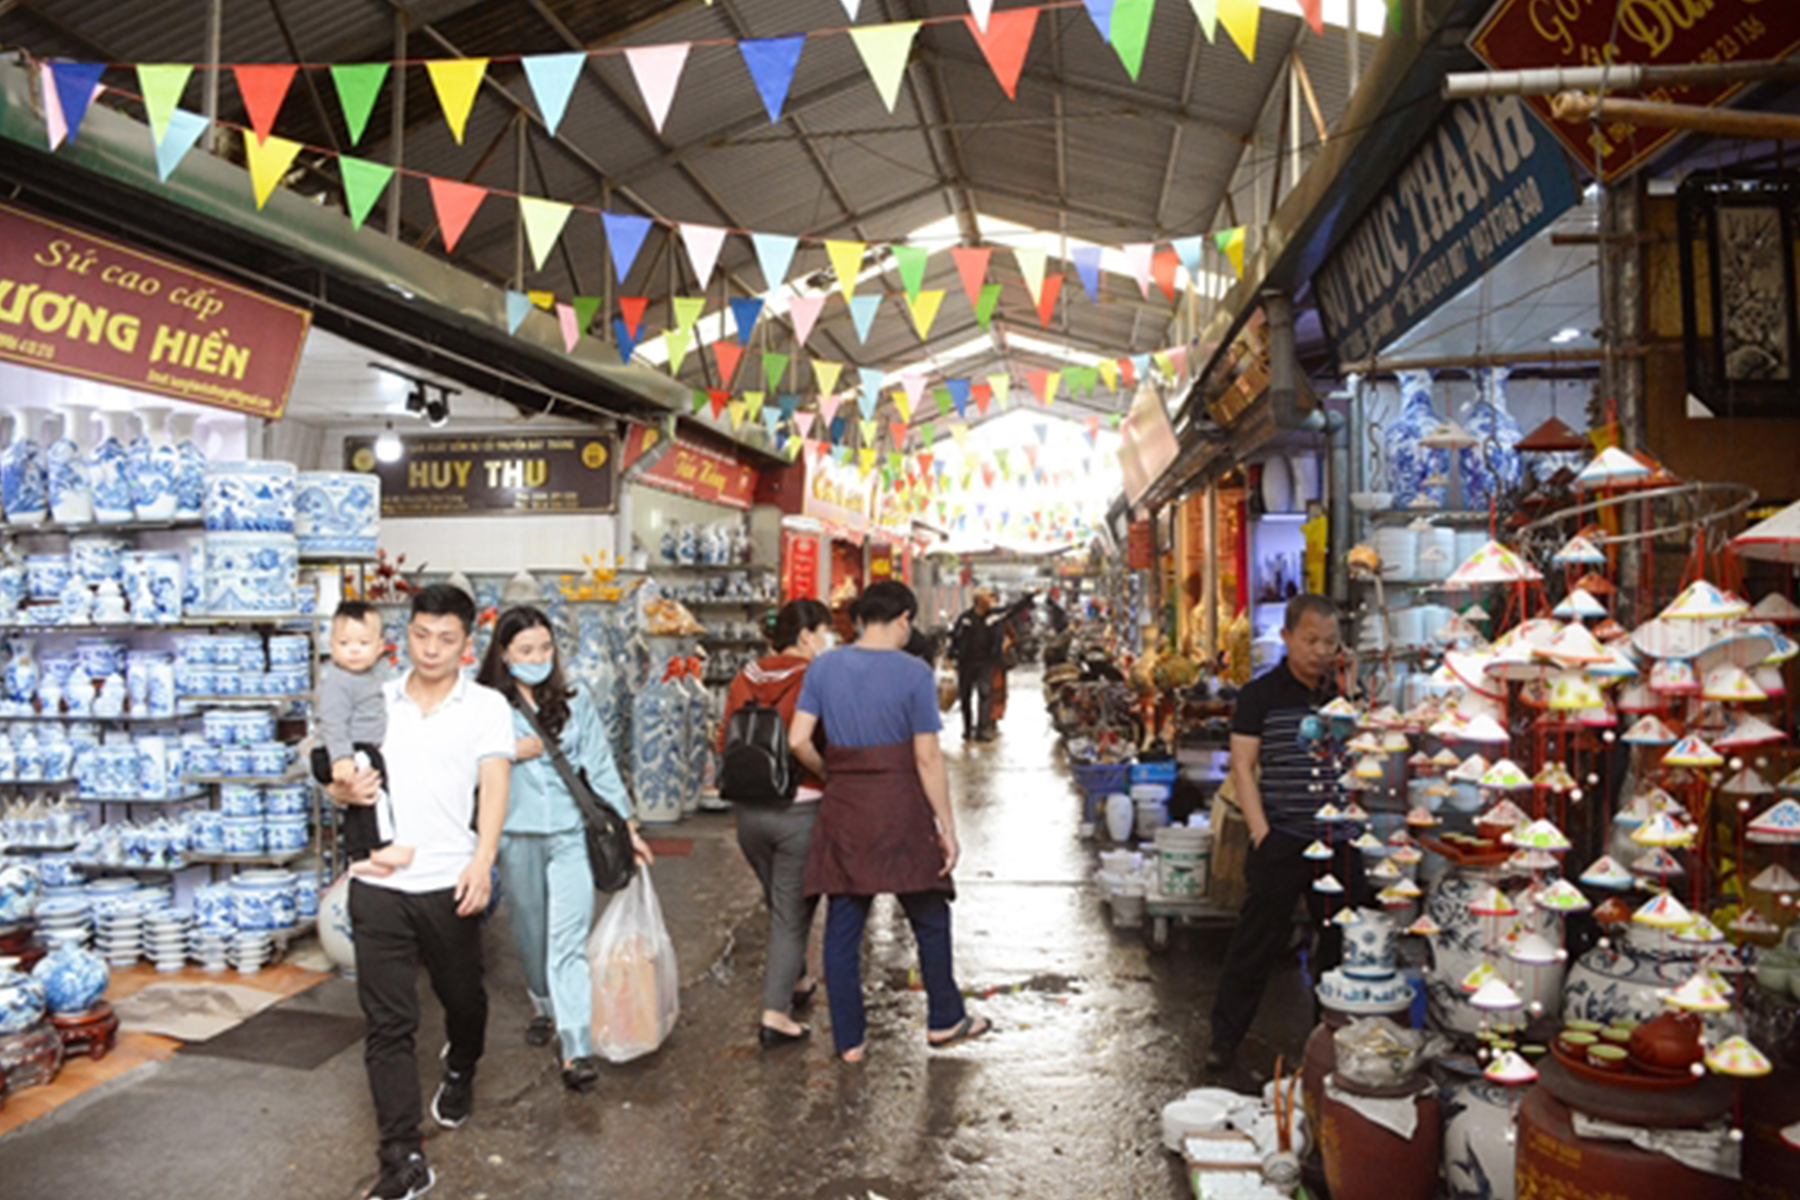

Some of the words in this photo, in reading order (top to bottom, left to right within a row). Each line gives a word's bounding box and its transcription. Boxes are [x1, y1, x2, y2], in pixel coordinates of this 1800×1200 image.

[34, 240, 99, 276] Sứ
[101, 264, 161, 296] cao
[168, 286, 225, 322] cấp
[149, 323, 252, 381] HIỀN
[408, 460, 473, 489] HUY
[484, 458, 549, 489] THU
